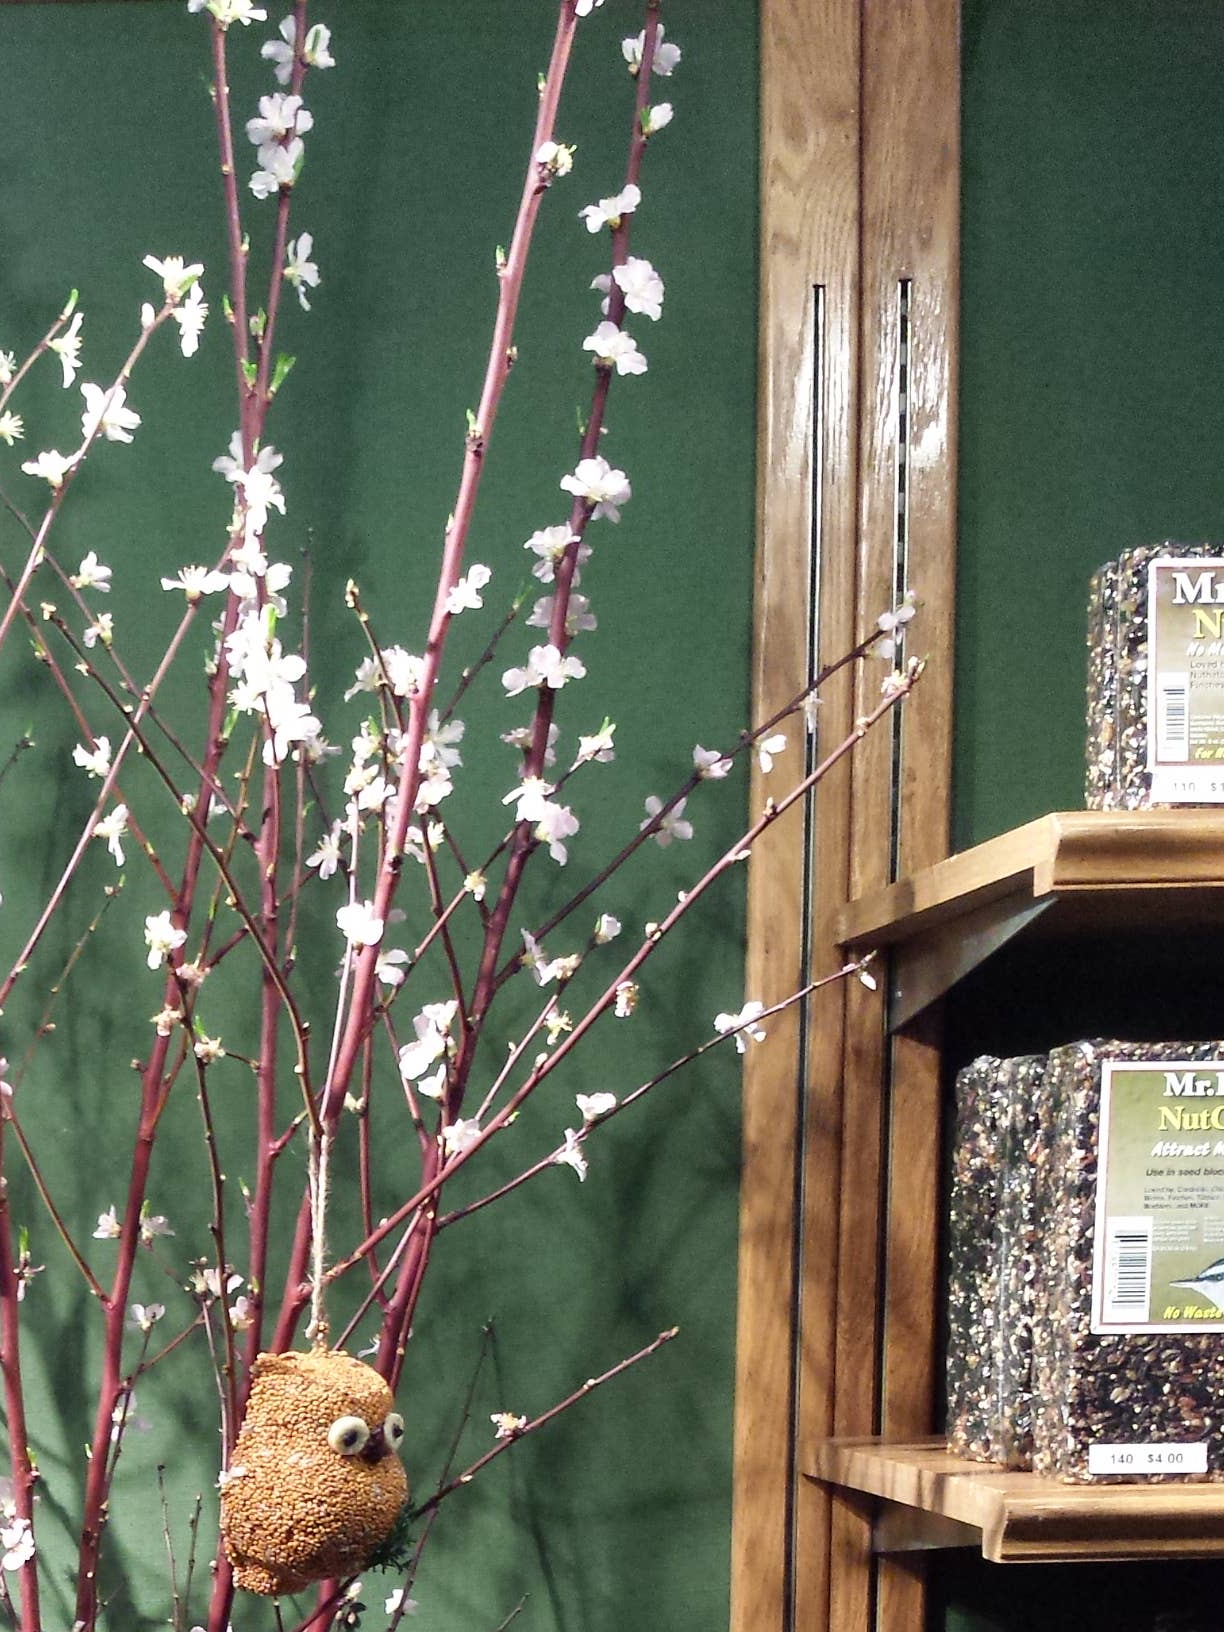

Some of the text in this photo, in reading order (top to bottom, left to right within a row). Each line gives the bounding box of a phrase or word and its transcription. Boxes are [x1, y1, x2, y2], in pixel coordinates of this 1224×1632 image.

[1151, 1141, 1211, 1157] Attract
[1146, 1169, 1164, 1177] Use
[1166, 1169, 1175, 1177] in
[1178, 1168, 1201, 1177] seed
[1163, 1306, 1180, 1319] No
[1112, 1454, 1133, 1464] 140
